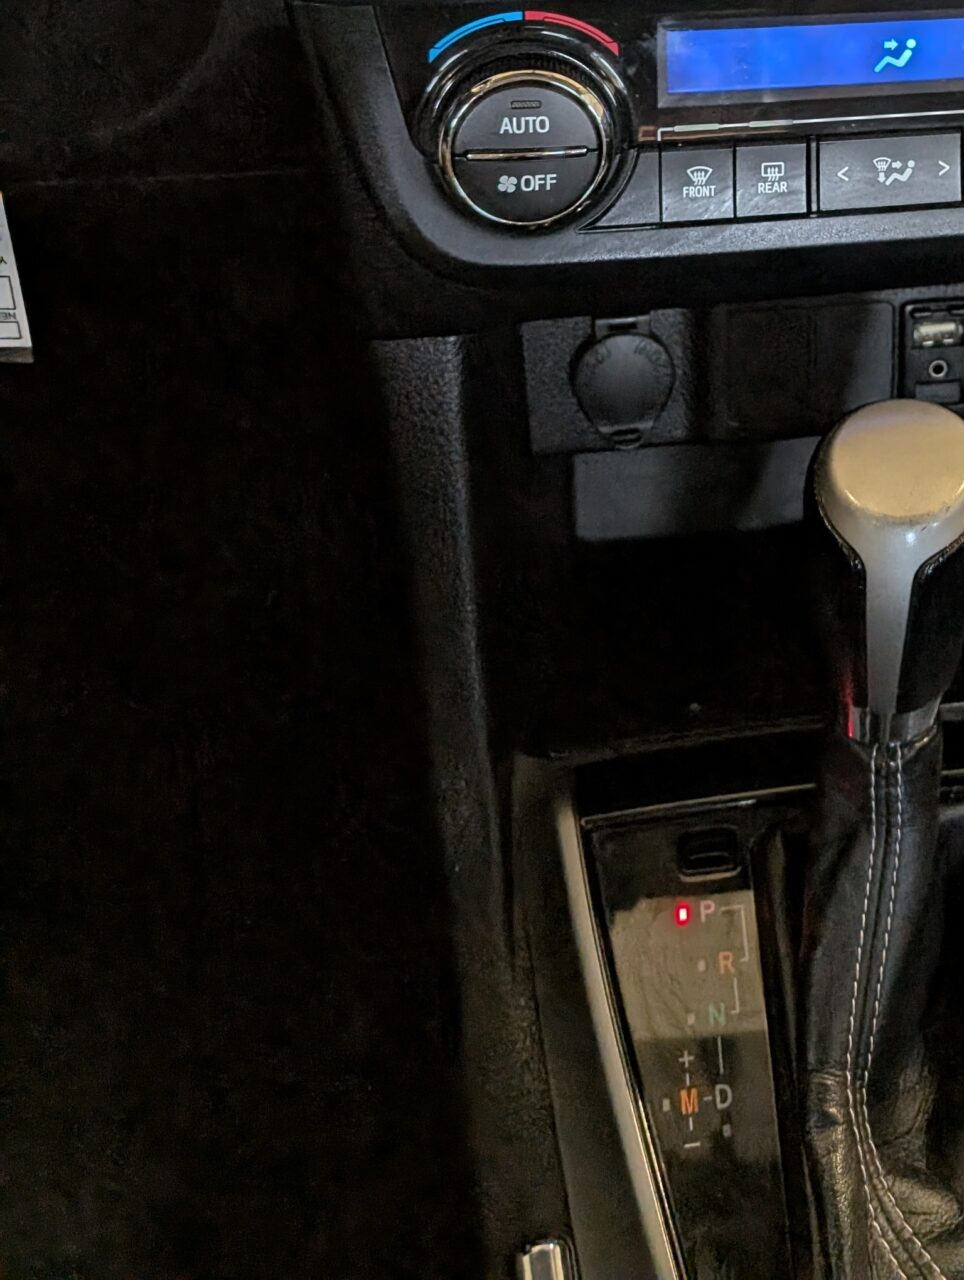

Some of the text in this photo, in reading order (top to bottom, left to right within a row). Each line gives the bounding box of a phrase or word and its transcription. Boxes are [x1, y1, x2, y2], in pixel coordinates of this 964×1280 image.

[499, 115, 550, 134] AUTO
[520, 173, 557, 193] OFF
[682, 184, 716, 198] FRONT
[757, 180, 788, 194] REAR
[700, 900, 715, 922] P
[718, 951, 735, 974] R
[709, 1002, 725, 1026] N
[679, 1084, 732, 1114] M D
